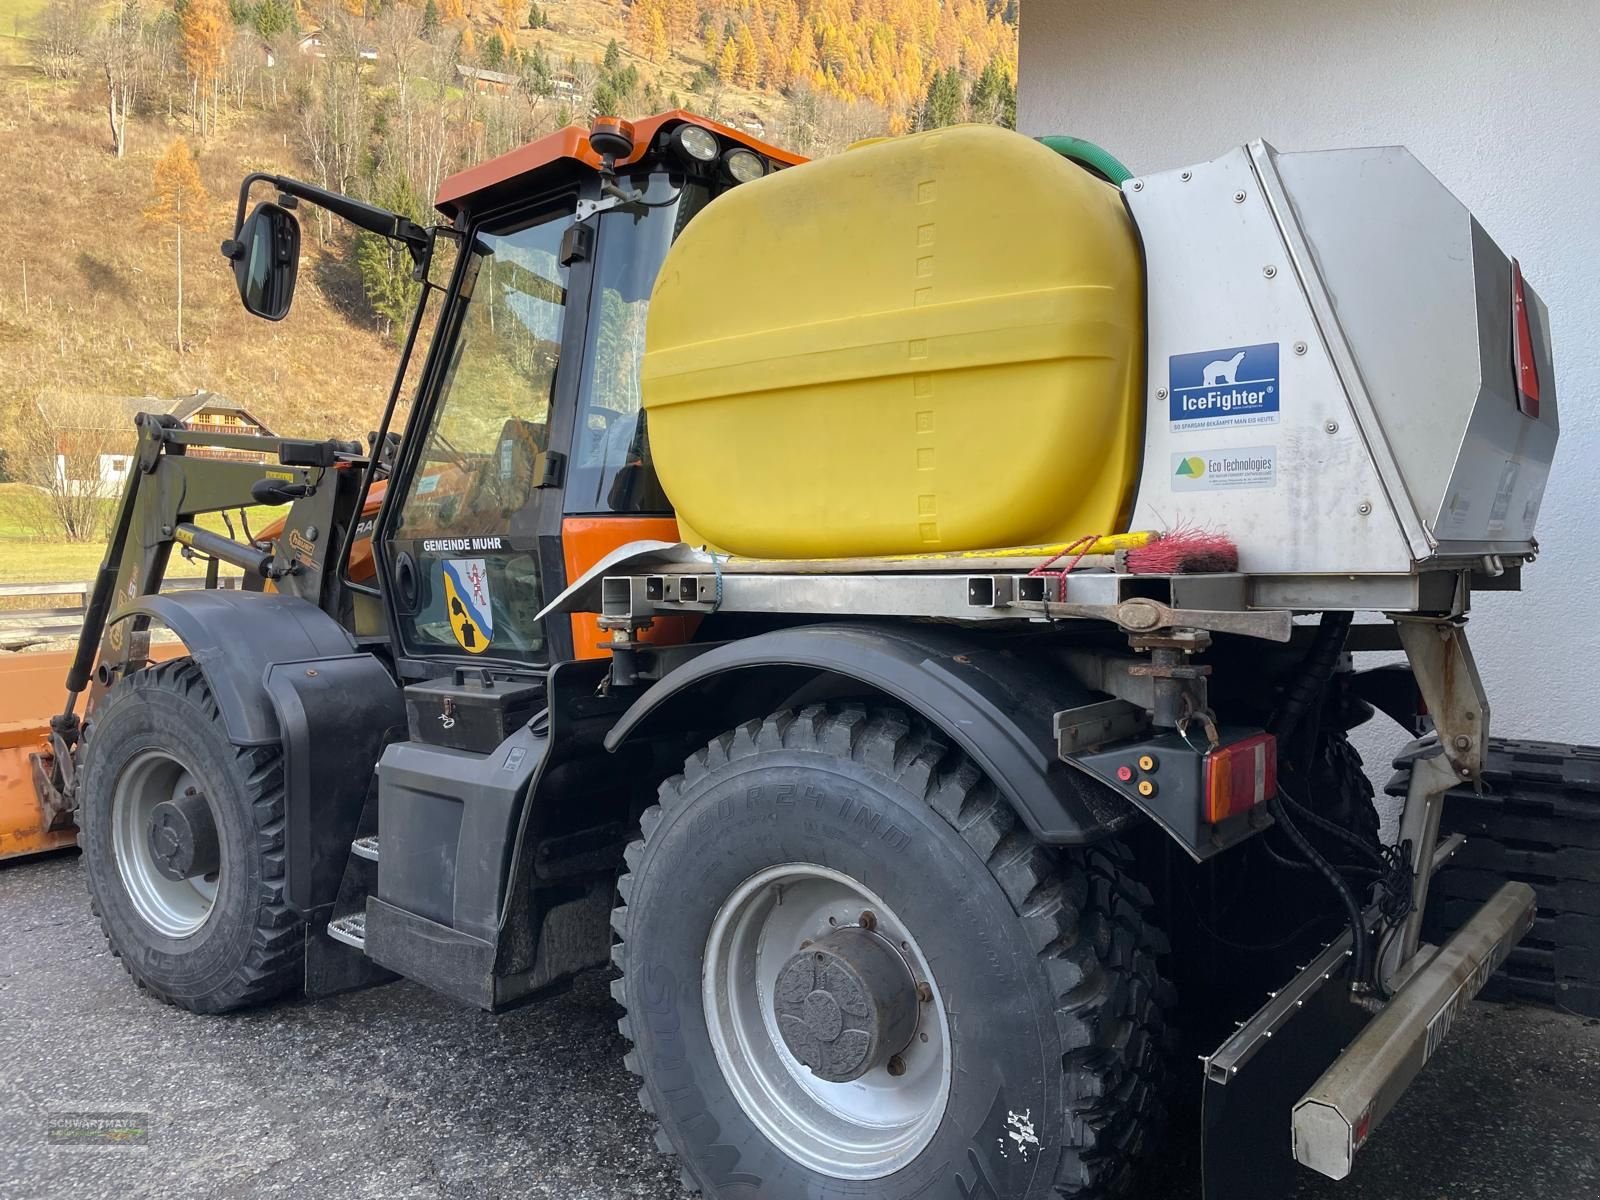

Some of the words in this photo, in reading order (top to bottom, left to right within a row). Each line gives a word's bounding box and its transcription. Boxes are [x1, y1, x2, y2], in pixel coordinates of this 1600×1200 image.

[1208, 459, 1222, 473] Eco
[1223, 456, 1272, 472] Technologies
[423, 539, 471, 551] GEMEINDE
[472, 537, 502, 550] MUHR
